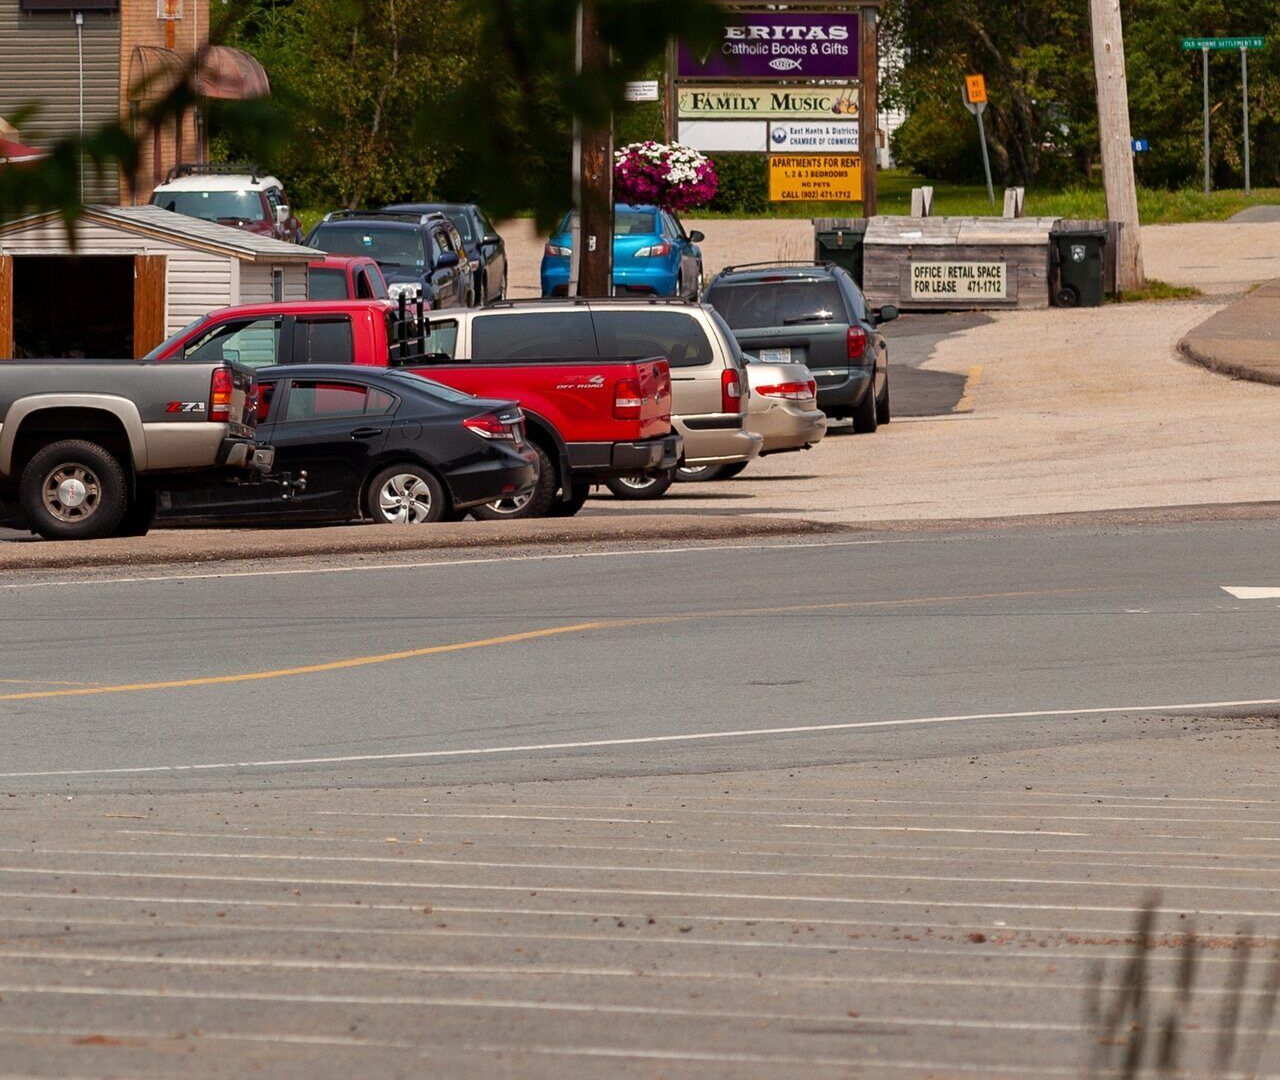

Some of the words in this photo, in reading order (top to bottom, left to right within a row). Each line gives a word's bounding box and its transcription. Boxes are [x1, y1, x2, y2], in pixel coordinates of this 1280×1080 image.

[724, 25, 849, 40] ERITAS
[722, 41, 769, 55] Catholic
[772, 42, 807, 55] Books
[810, 43, 819, 55] &
[821, 42, 849, 55] Gifts
[691, 93, 761, 110] FAMILY
[770, 93, 831, 110] MUSIC
[832, 127, 858, 135] Districts
[772, 158, 821, 167] APARTMENTS
[824, 158, 838, 167] FOR
[840, 158, 860, 167] RENT
[781, 191, 799, 199] CALL
[801, 191, 818, 199] (902)
[914, 267, 941, 278] OFFICE
[948, 266, 975, 278] RETAIL
[977, 266, 1001, 278] SPACE
[914, 281, 930, 292] FOR
[932, 281, 956, 292] LEASE
[967, 280, 1001, 292] 471-1712
[166, 401, 205, 412] Z71
